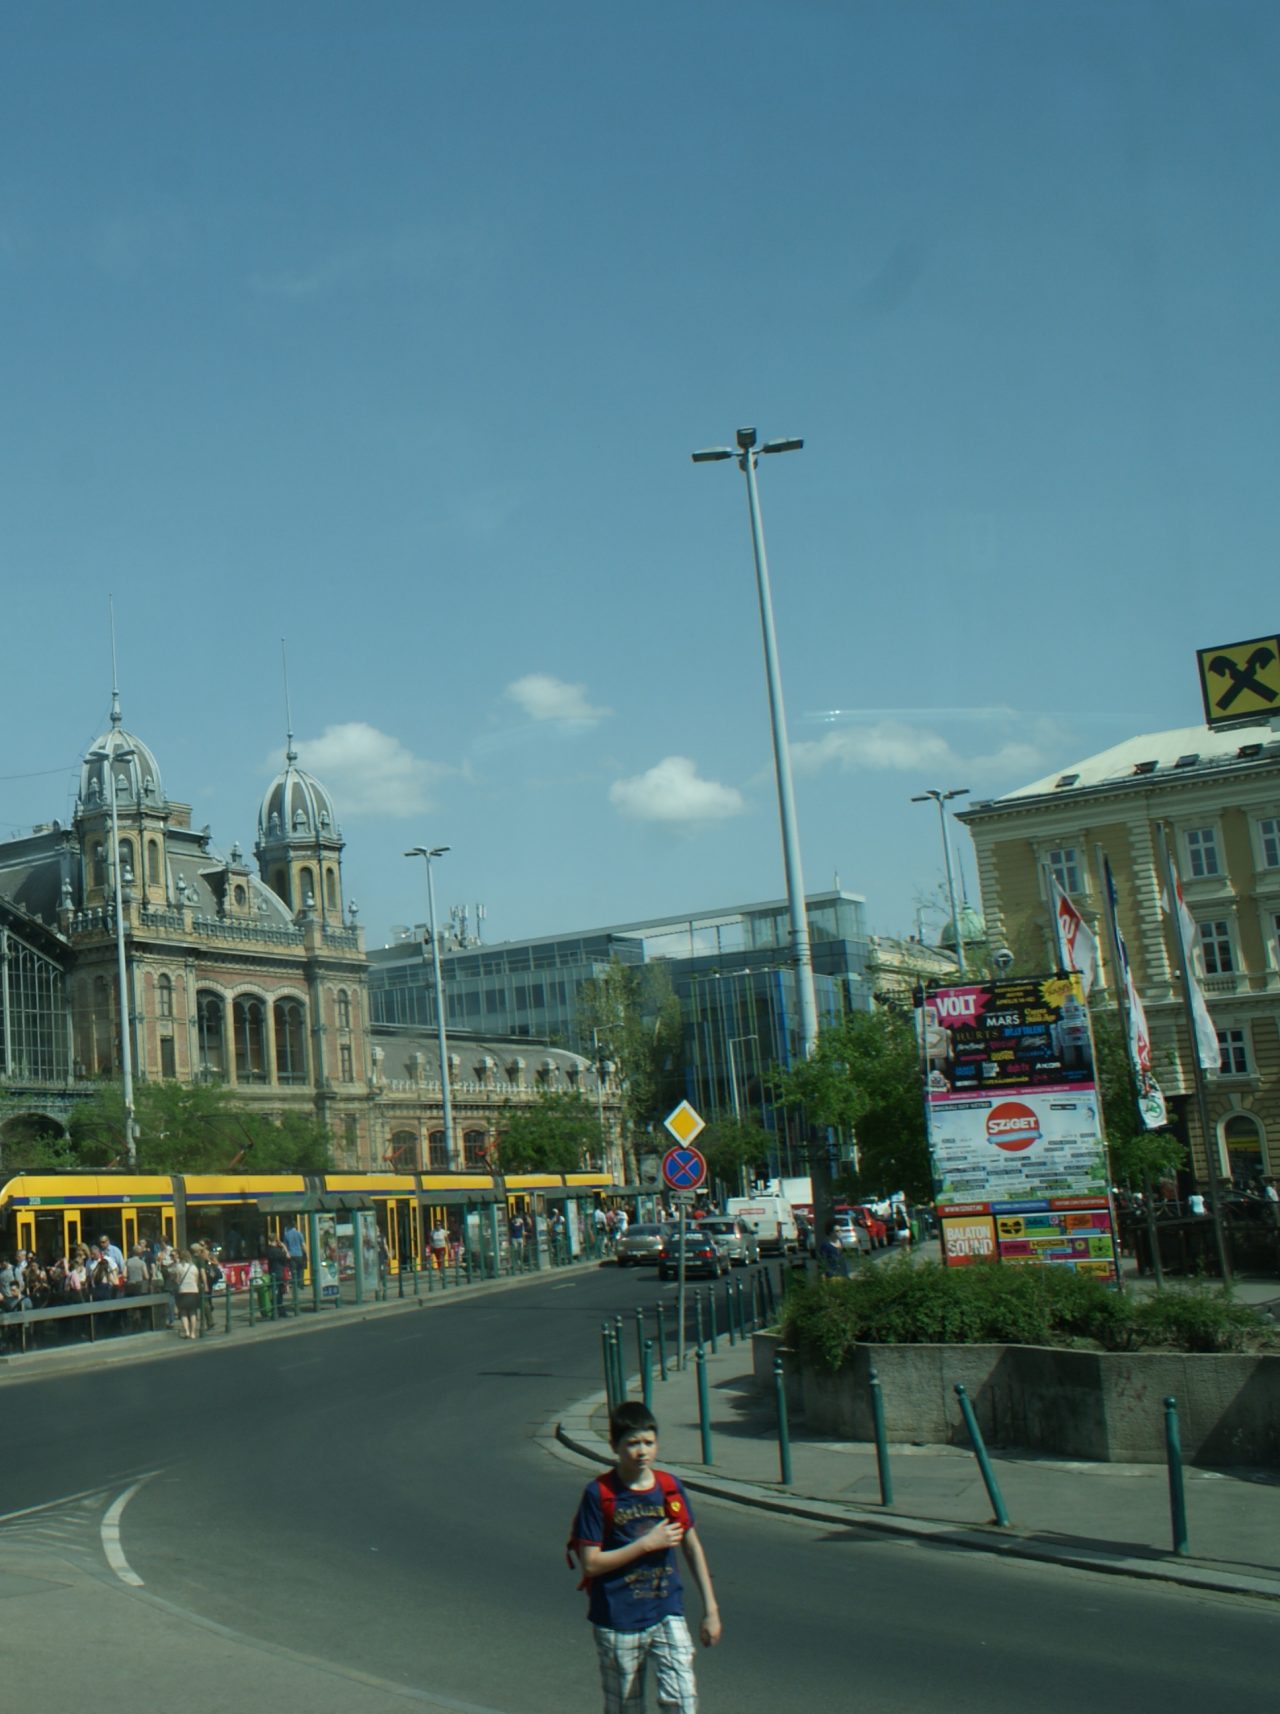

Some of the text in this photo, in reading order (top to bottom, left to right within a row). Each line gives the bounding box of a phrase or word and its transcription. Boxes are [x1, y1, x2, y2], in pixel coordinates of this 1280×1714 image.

[936, 995, 977, 1016] VOLT
[986, 1014, 1021, 1027] MARS
[946, 1225, 990, 1239] BALATON
[947, 1239, 992, 1256] SOUND
